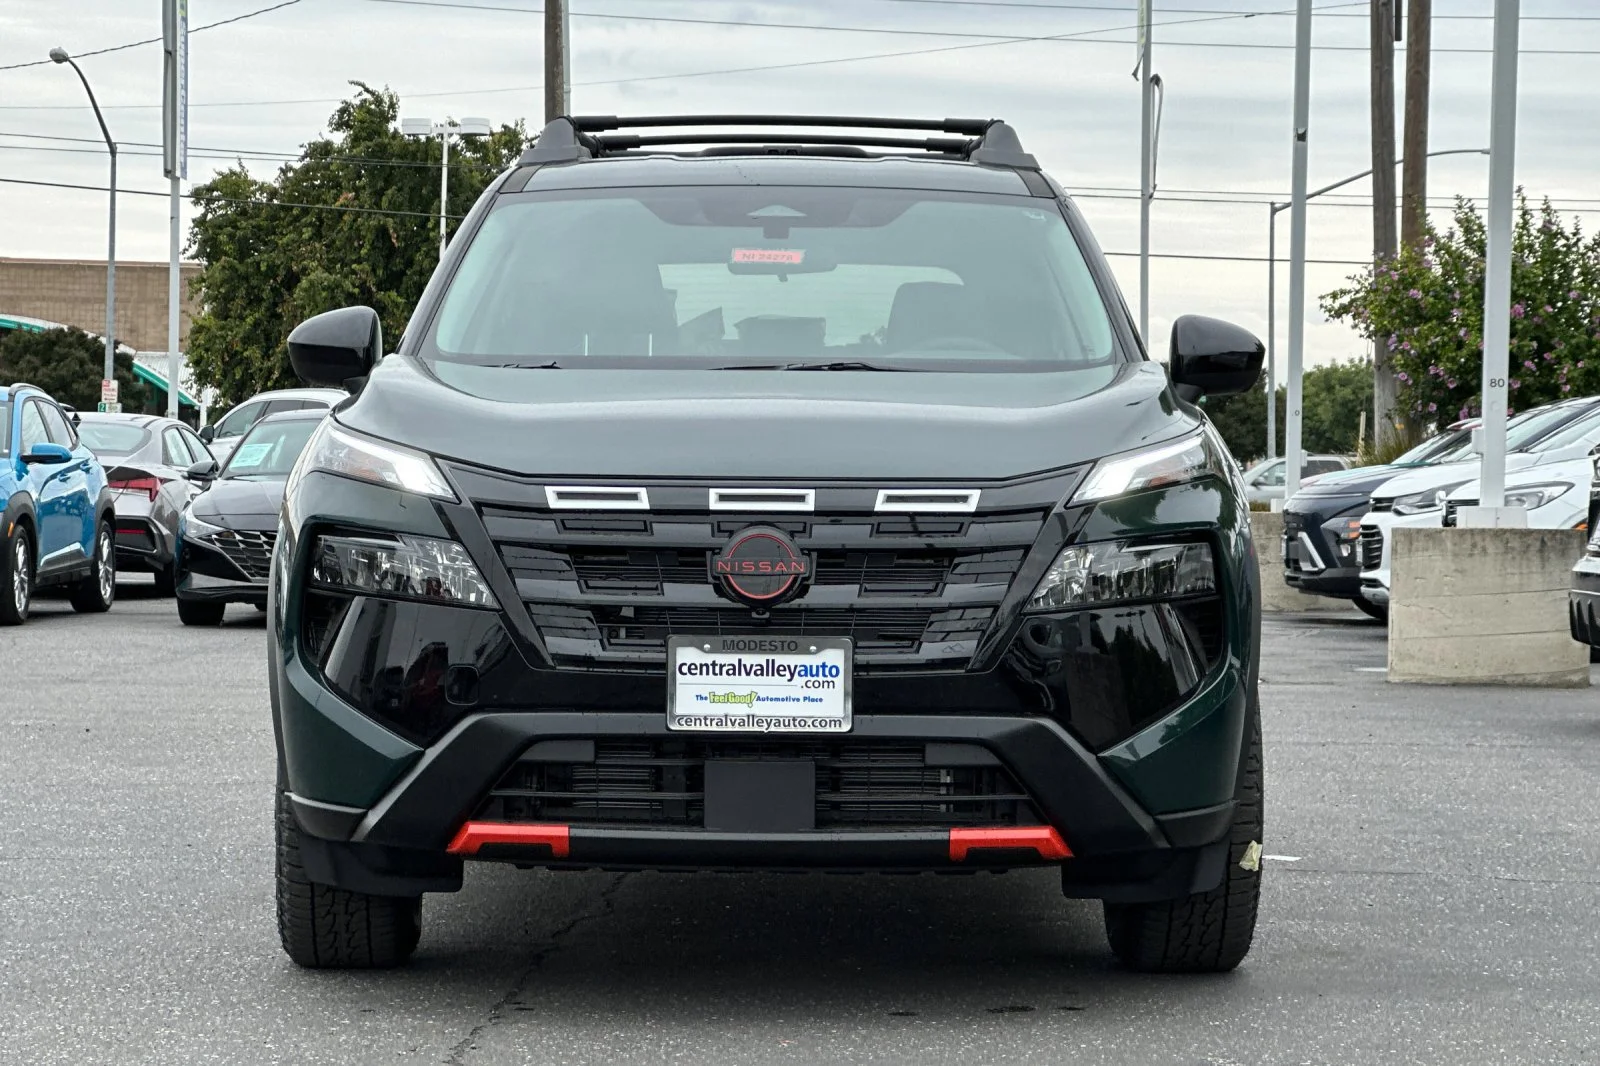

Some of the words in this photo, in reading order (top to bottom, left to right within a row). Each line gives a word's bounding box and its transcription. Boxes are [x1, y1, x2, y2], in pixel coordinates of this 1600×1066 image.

[1490, 378, 1505, 388] 80
[718, 561, 805, 572] NISSAN
[722, 640, 798, 652] MODESTO
[678, 658, 840, 682] centralvalleyauto
[801, 680, 835, 689] .com
[756, 695, 800, 703] Automotive
[677, 714, 842, 730] centralvalleyauto.com
